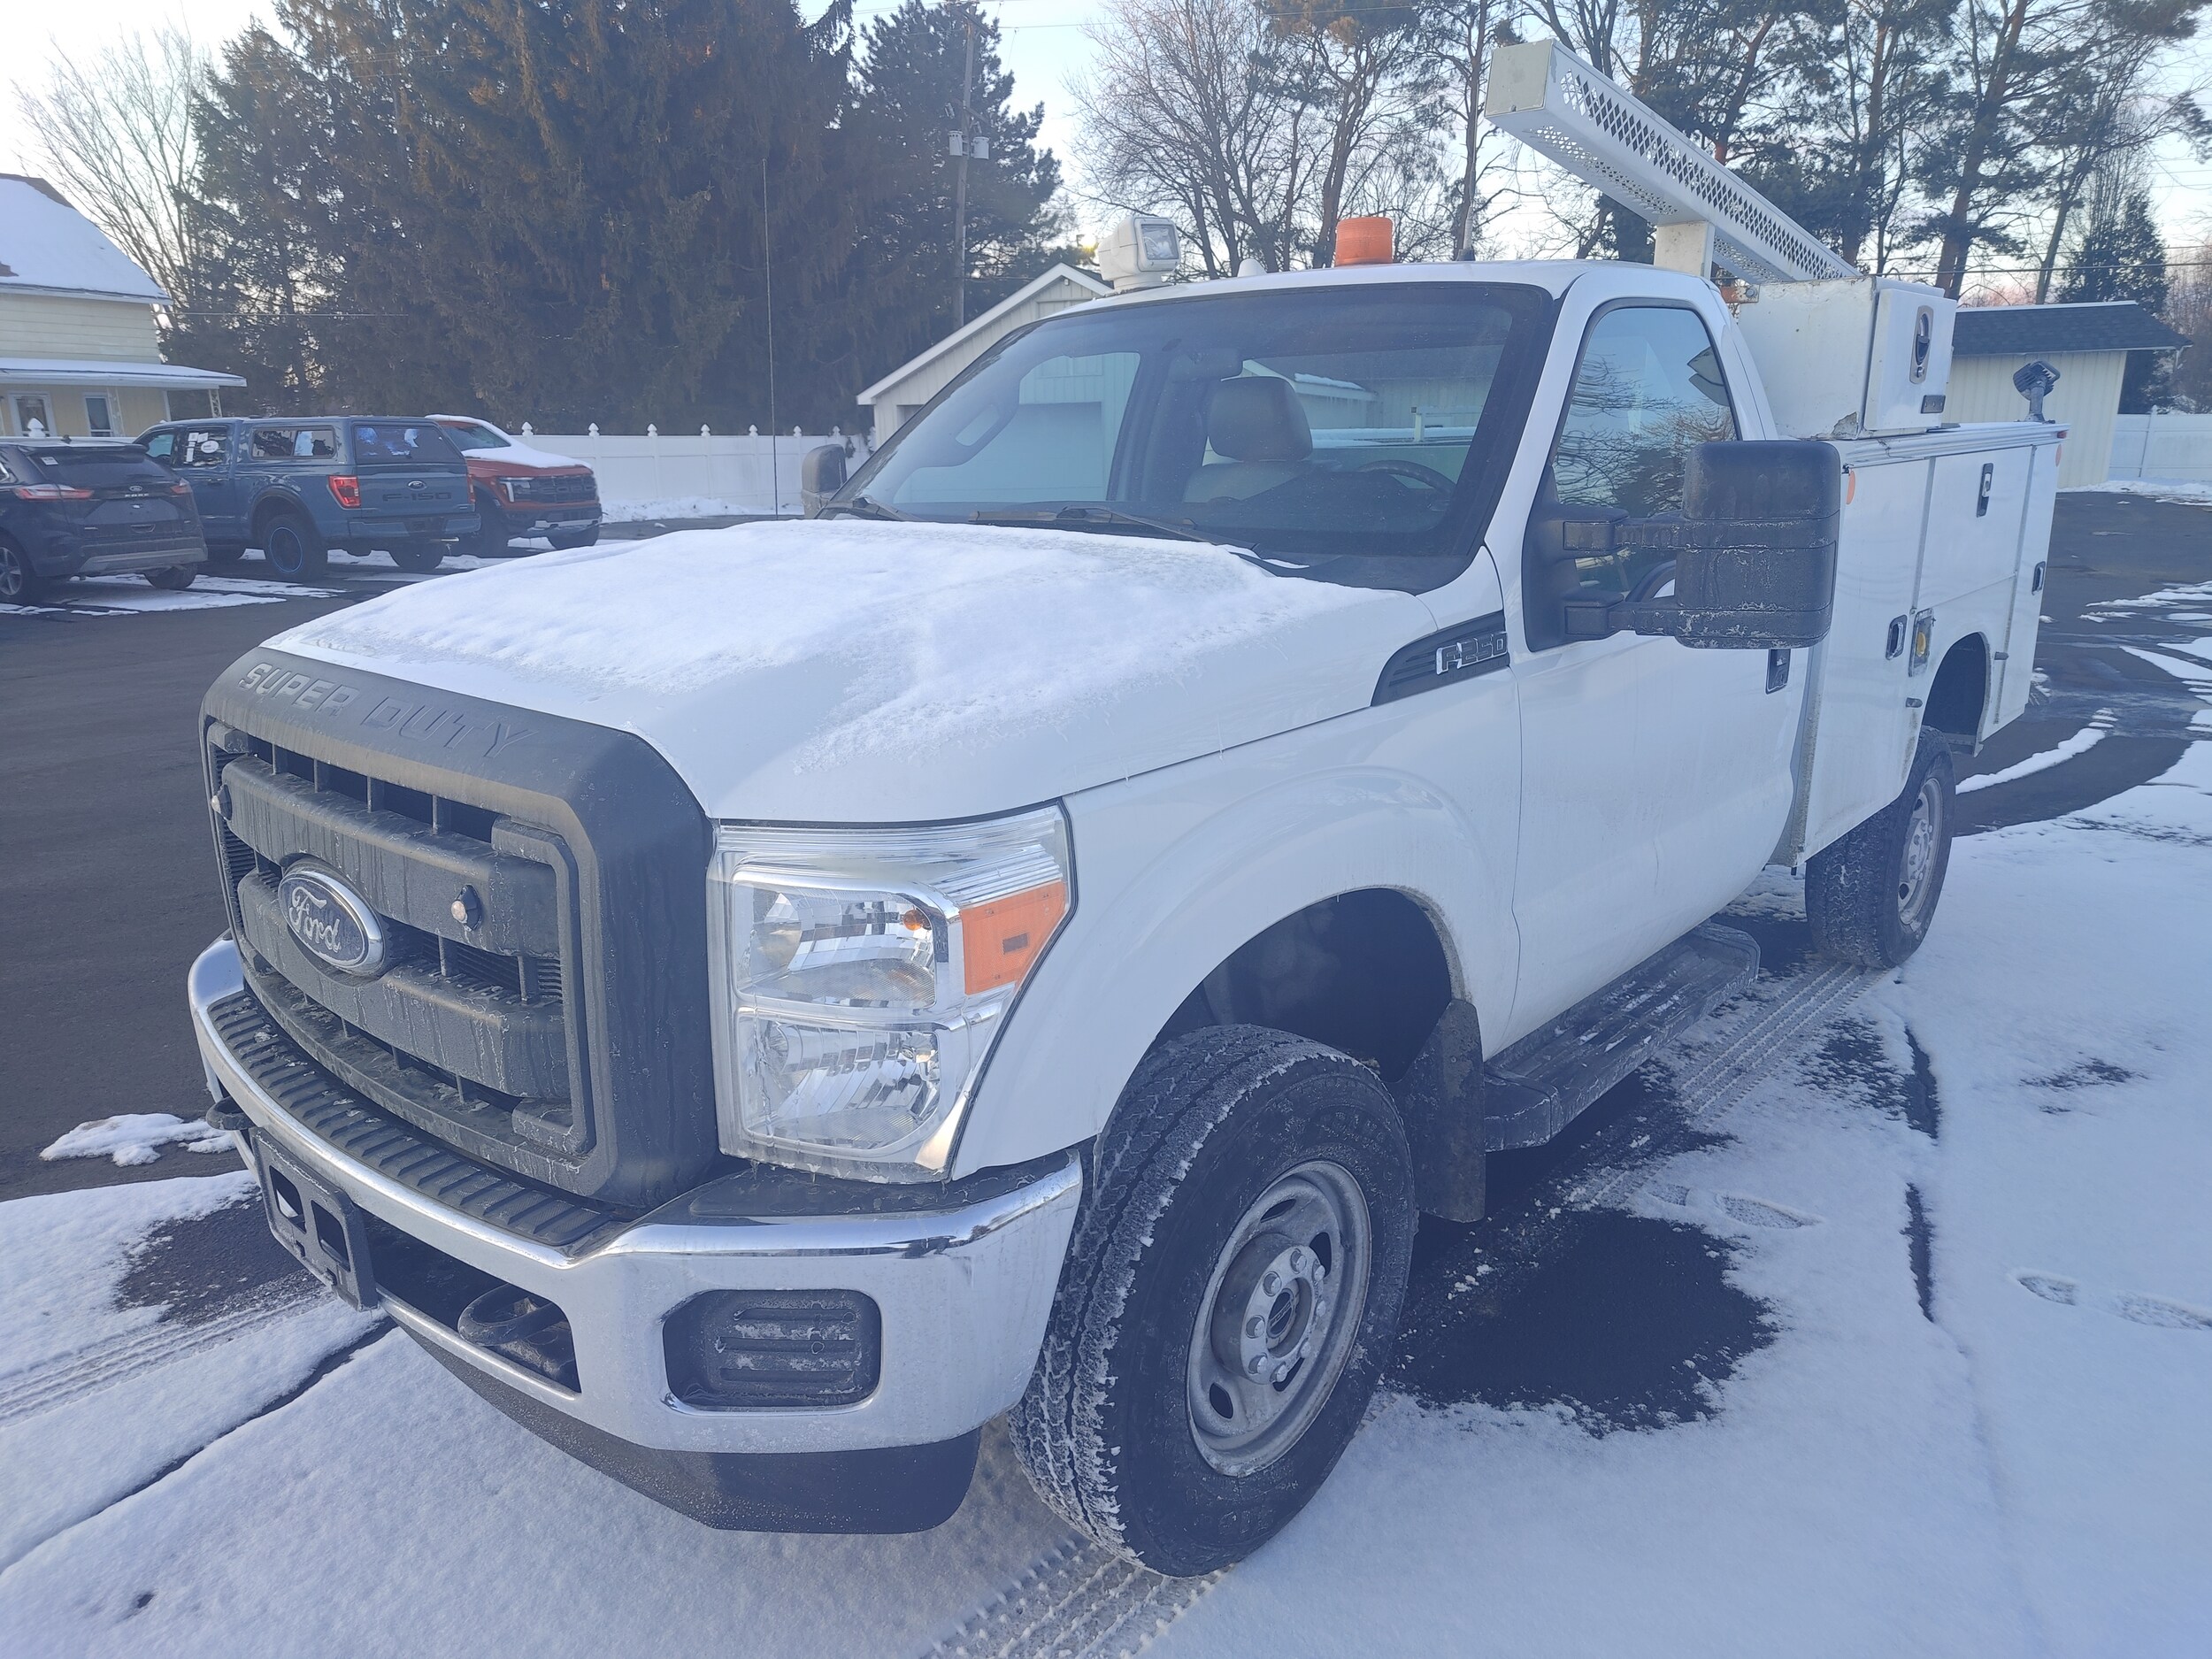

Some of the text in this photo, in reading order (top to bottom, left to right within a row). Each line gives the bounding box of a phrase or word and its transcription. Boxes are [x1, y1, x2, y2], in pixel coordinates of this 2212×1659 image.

[382, 492, 451, 502] F-150
[238, 663, 539, 759] SUPER DUTY
[288, 886, 342, 953] Ford
